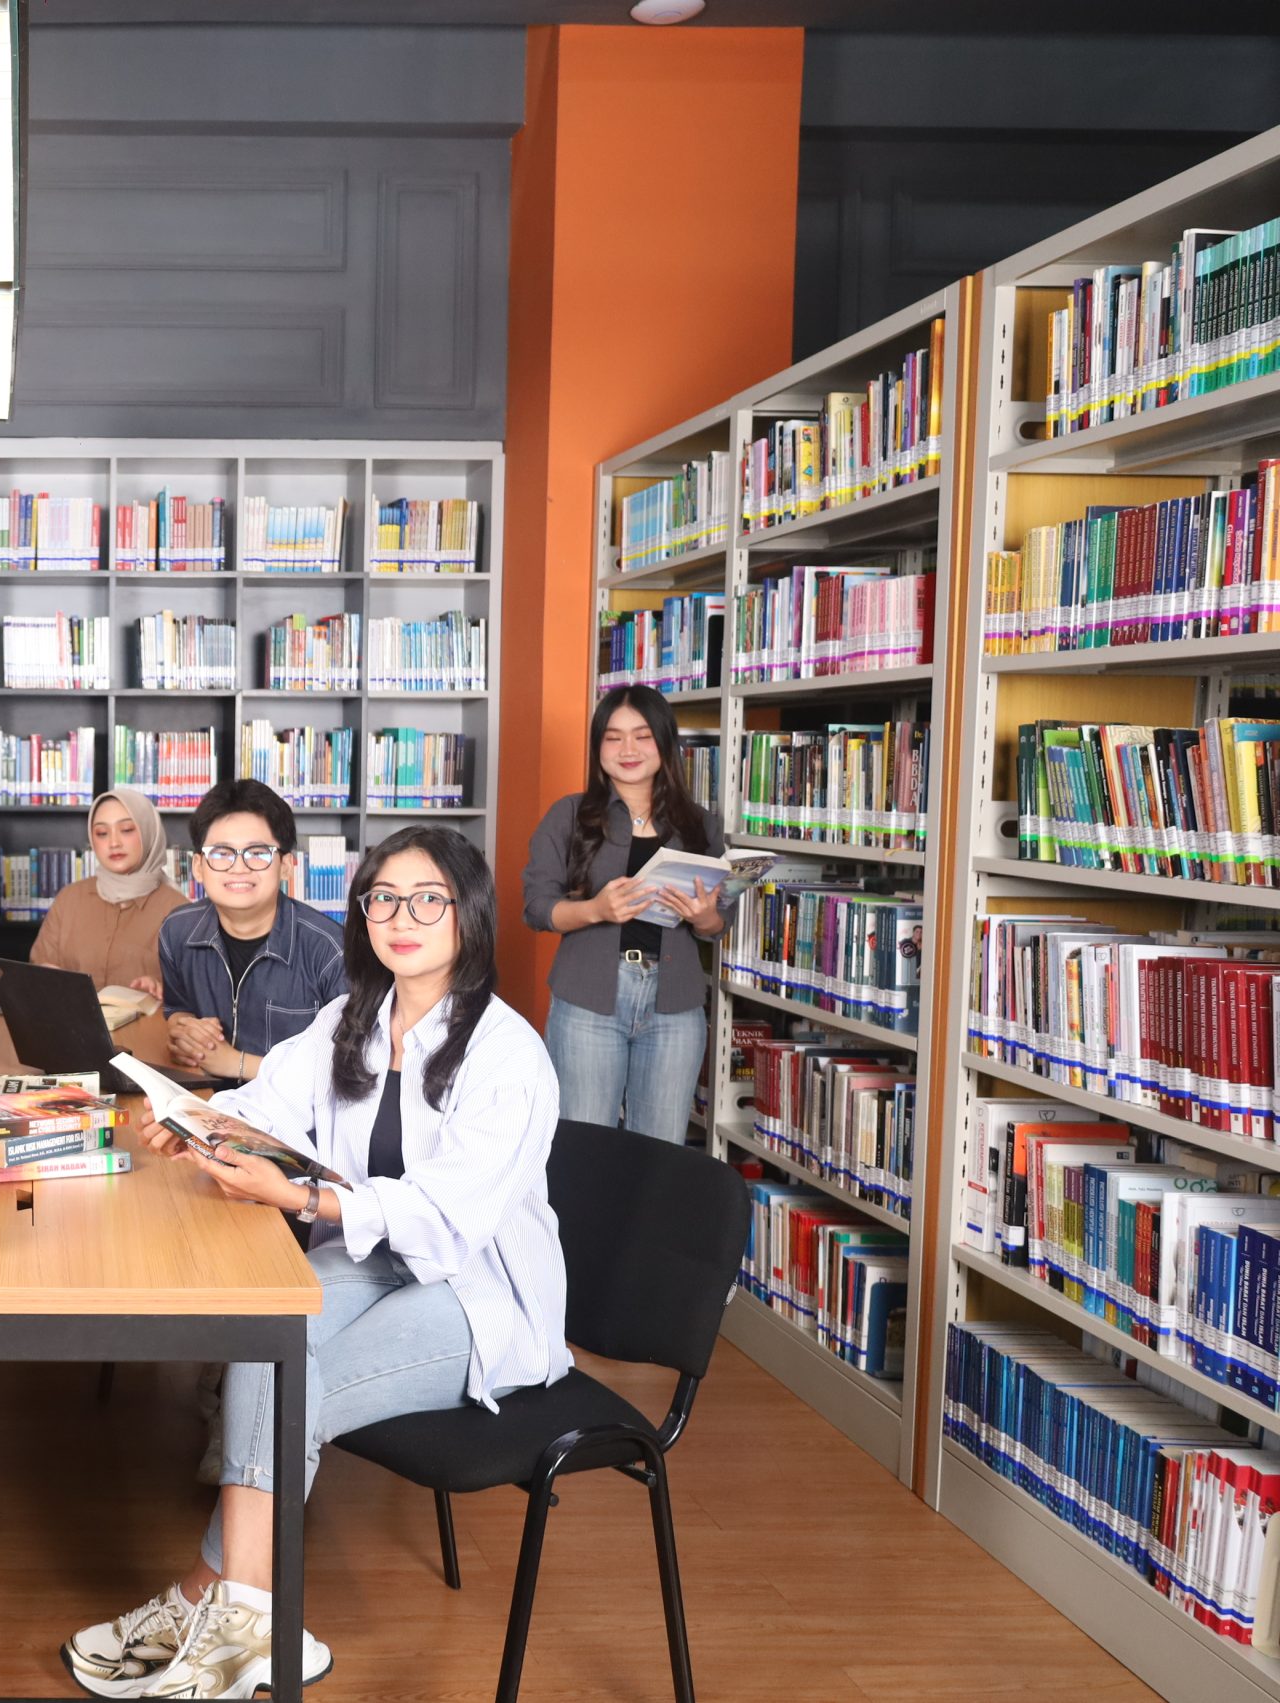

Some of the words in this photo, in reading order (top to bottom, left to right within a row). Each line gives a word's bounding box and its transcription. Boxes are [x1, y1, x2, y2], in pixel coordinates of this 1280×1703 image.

[732, 1029, 764, 1040] TEKNIK
[8, 1146, 25, 1156] ISLAMIC
[26, 1144, 36, 1153] RISK
[36, 1136, 65, 1149] MANAGEMENT
[66, 1134, 76, 1142] FOR
[37, 1165, 58, 1173] SIRAH
